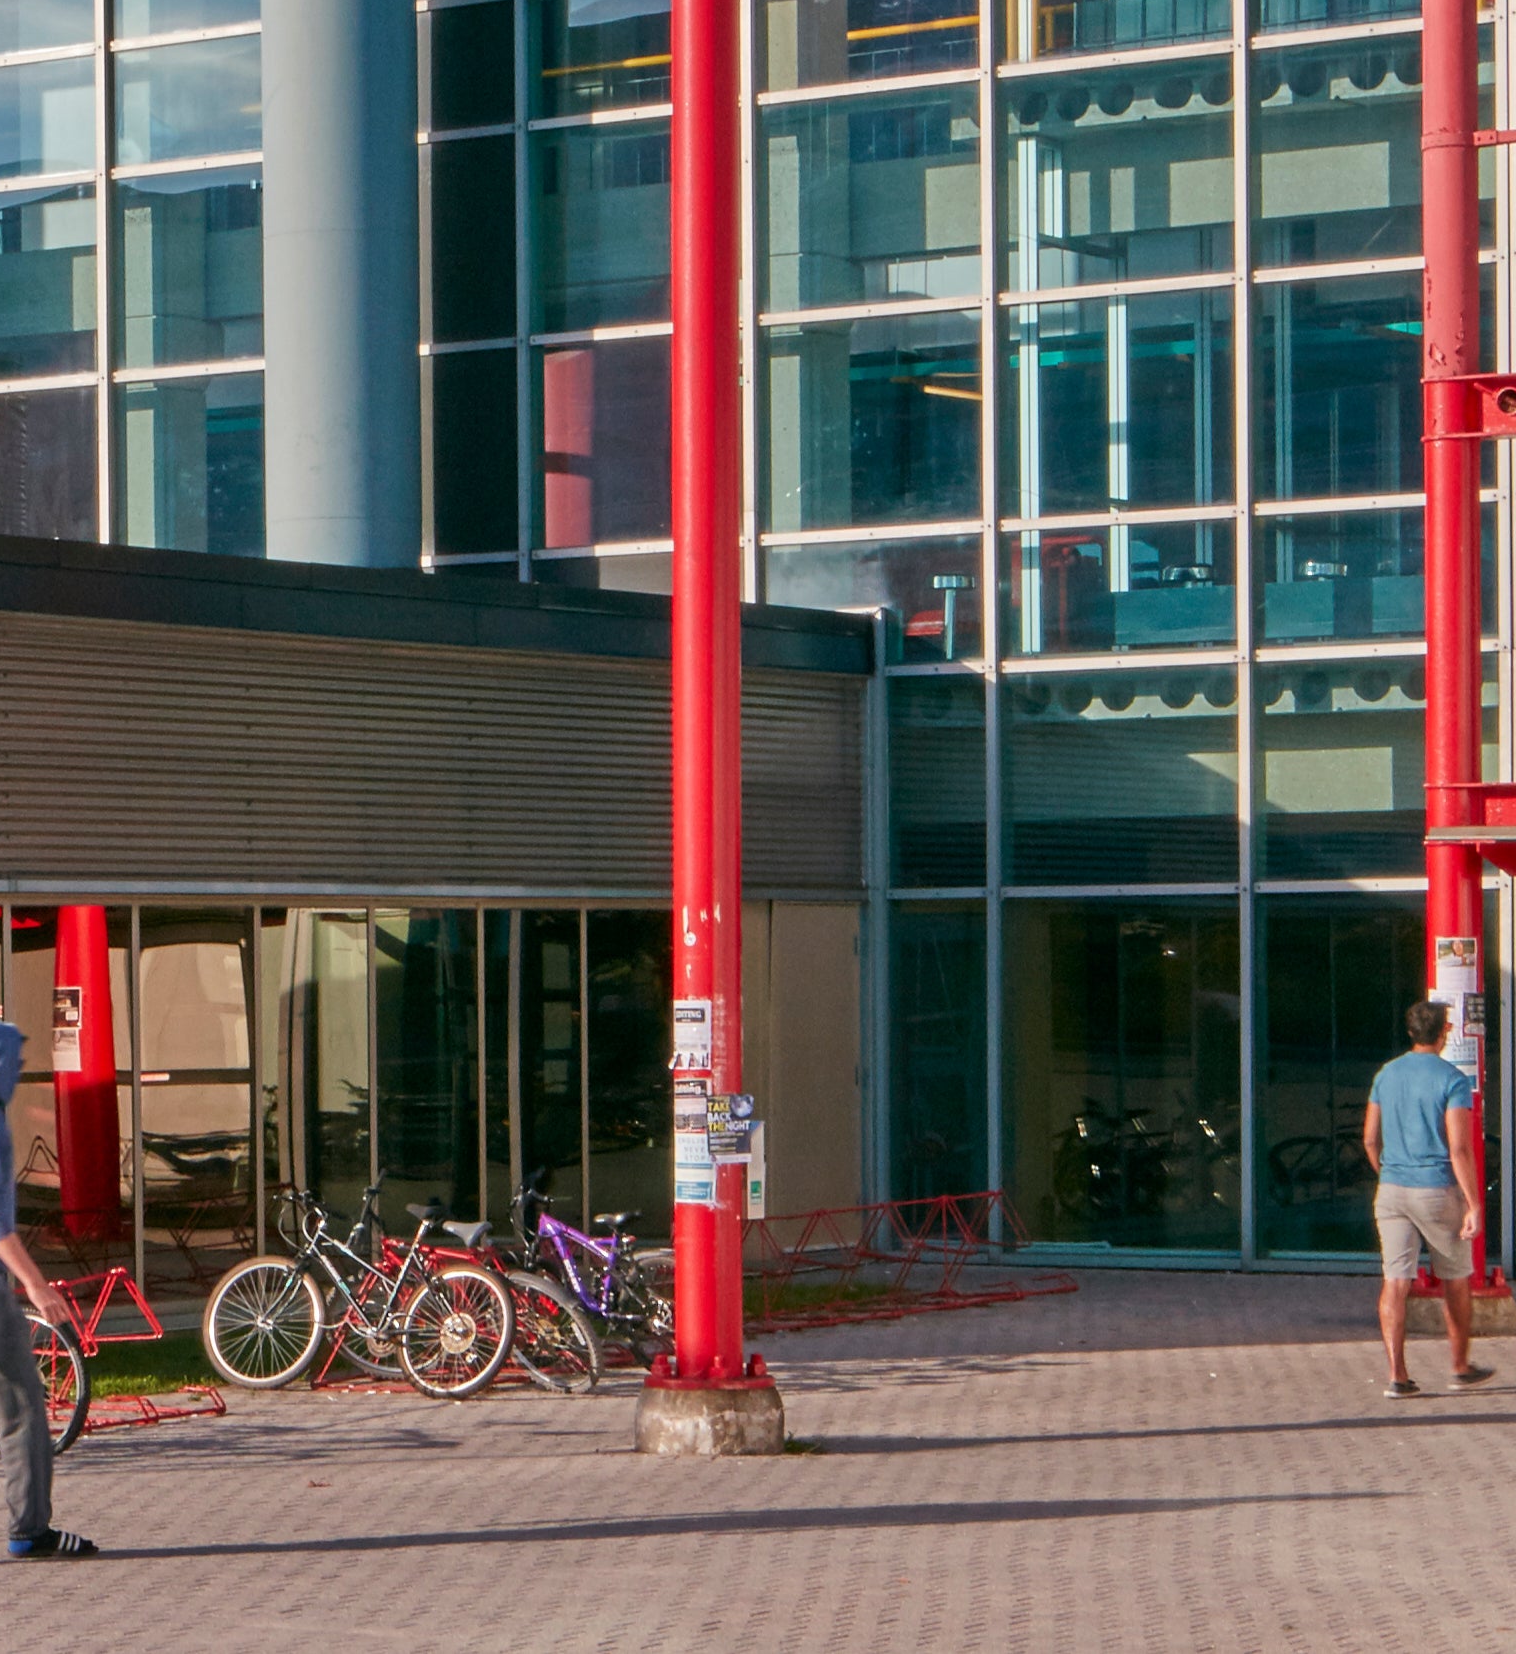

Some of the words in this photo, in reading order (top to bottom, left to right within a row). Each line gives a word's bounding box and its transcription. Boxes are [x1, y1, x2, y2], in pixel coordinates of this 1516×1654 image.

[707, 1102, 730, 1112] TAKE
[707, 1112, 731, 1122] BACK
[708, 1121, 725, 1131] THE
[725, 1119, 751, 1131] NIGHT
